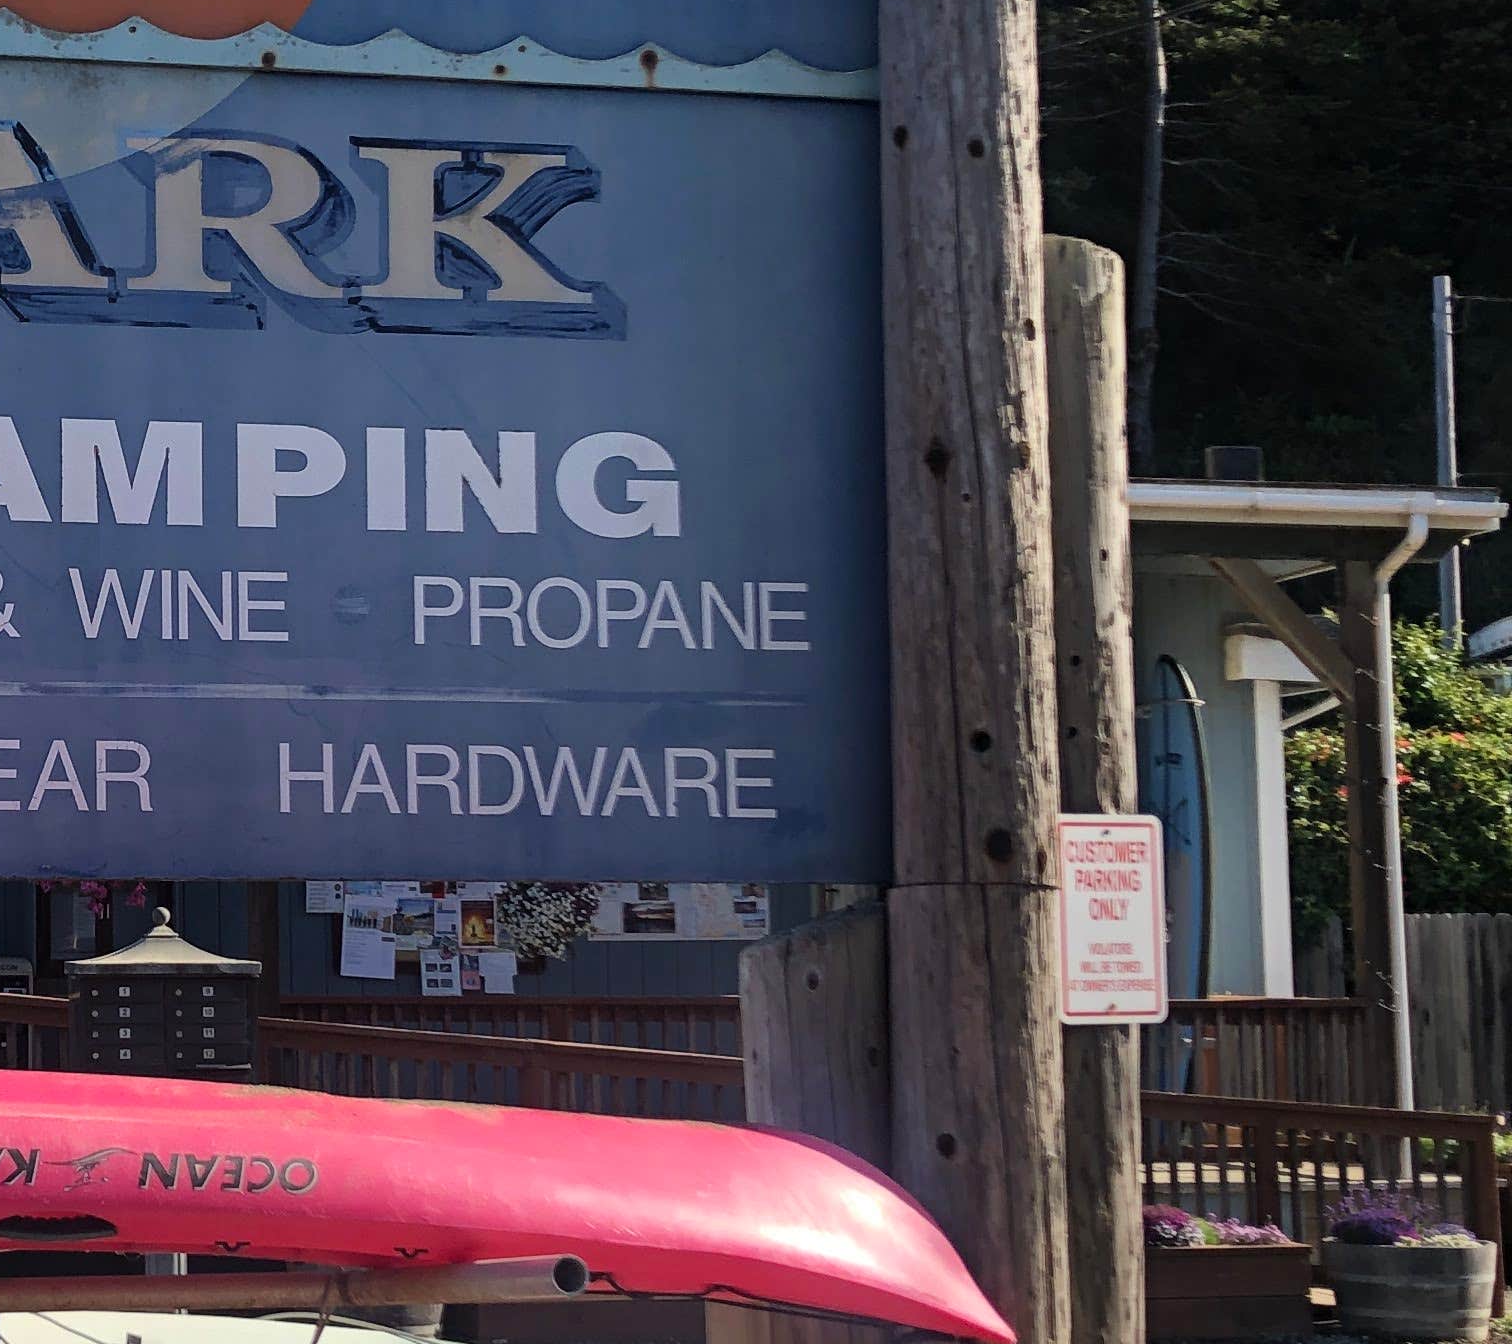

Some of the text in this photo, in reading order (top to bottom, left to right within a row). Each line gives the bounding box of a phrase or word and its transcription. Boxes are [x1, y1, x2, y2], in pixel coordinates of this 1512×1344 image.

[68, 566, 289, 643] WINE
[412, 575, 812, 653] PROPANE
[279, 742, 779, 820] HARDWARE
[1065, 840, 1148, 864] CUSTOMER
[1074, 869, 1142, 892] PARKING
[1088, 898, 1129, 921] ONLY
[138, 1151, 320, 1194] OCEAN
